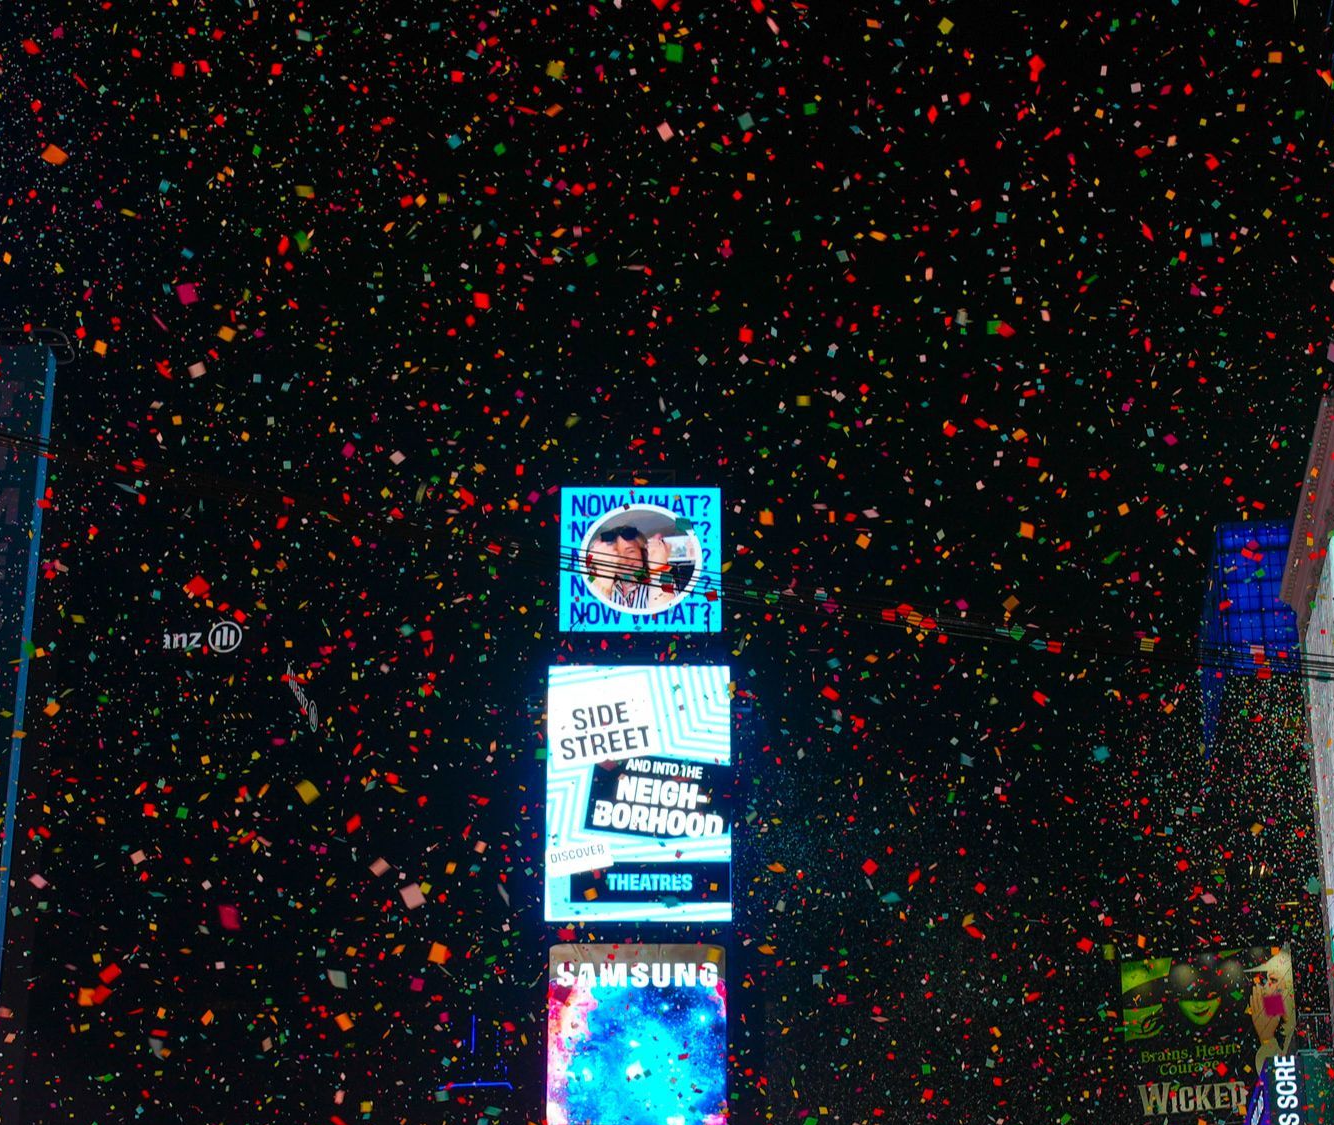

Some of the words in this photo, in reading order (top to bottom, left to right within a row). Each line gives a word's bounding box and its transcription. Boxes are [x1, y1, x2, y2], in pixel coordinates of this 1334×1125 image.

[572, 495, 624, 517] NOW
[570, 602, 622, 625] NOW
[572, 701, 630, 731] SIDE
[560, 725, 651, 761] STREET
[625, 757, 652, 773] AND
[652, 760, 680, 777] INTO
[616, 775, 711, 810] NEIGH-
[592, 799, 724, 838] BORHOOD
[550, 843, 606, 865] DISCOVER
[606, 872, 693, 892] THEATRES
[556, 961, 719, 989] SAMSUNG
